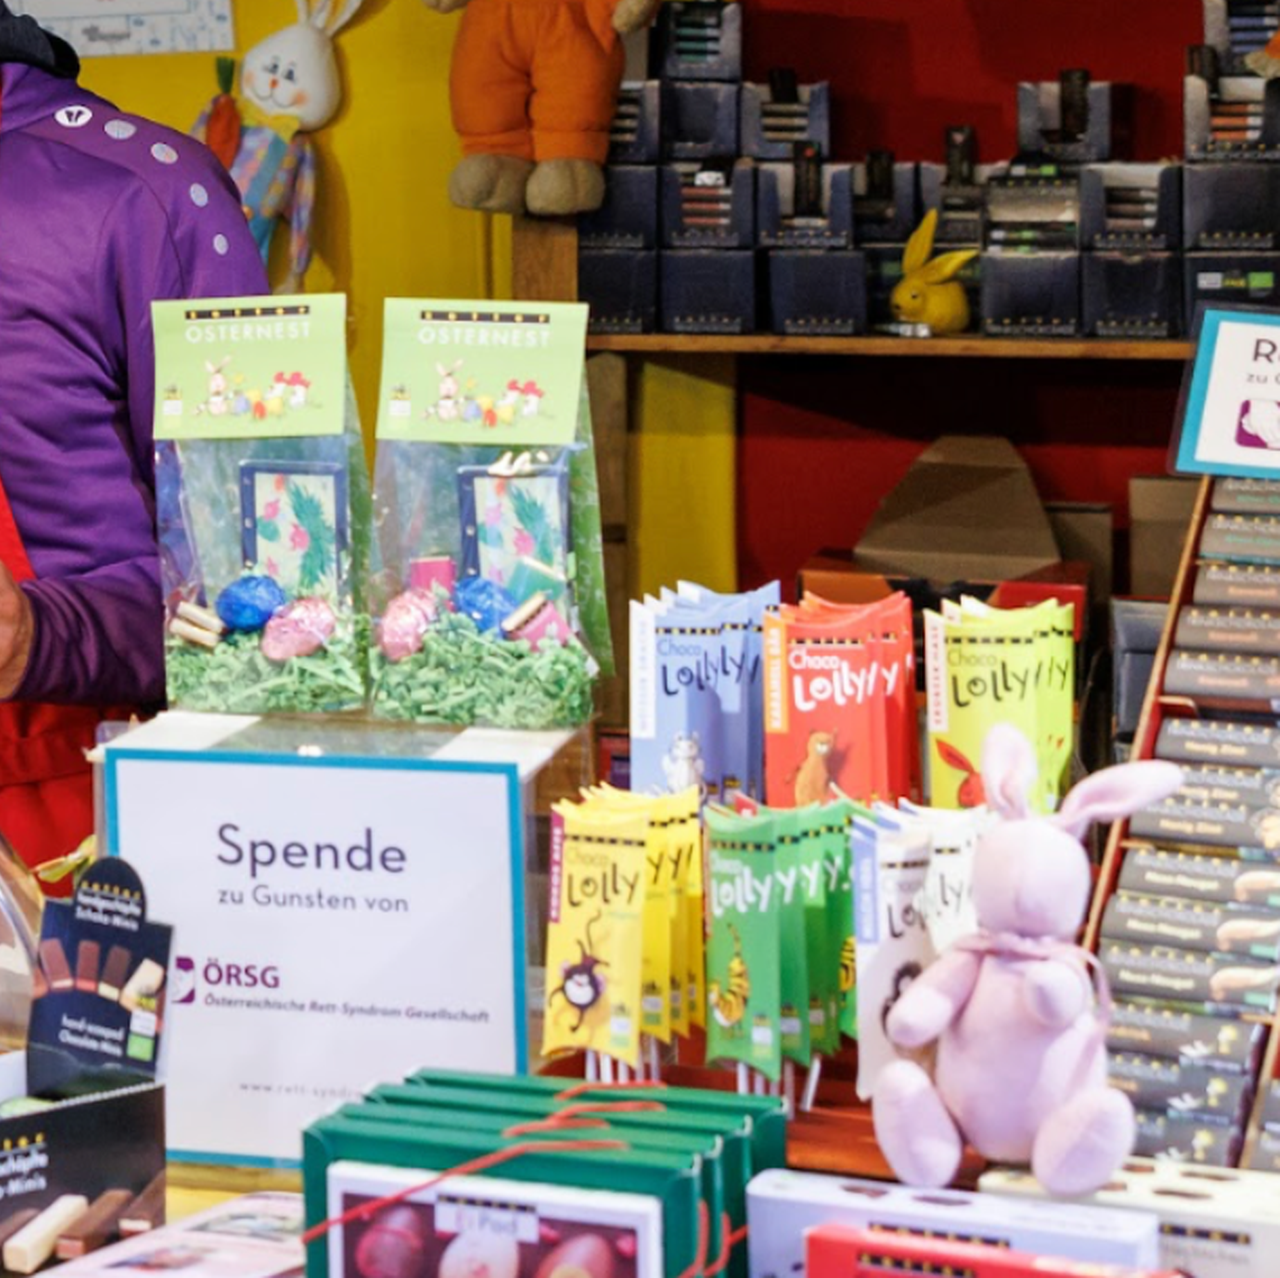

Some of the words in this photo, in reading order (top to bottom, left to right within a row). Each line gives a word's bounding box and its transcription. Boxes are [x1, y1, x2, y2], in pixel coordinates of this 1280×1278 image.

[185, 320, 311, 344] OSTERNEST
[417, 326, 551, 348] OSTERNEST
[788, 647, 840, 671] Choco
[951, 661, 1030, 709] Lolly
[216, 823, 408, 879] Spende
[217, 888, 244, 906] zu
[252, 884, 358, 913] Gunsten
[365, 893, 410, 914] von
[567, 862, 640, 908] Lolly
[710, 865, 773, 919] Lolly
[202, 956, 281, 990] ÖRSG
[203, 992, 308, 1014] Österreichische
[309, 999, 404, 1021] Rett-Syndrom
[405, 1003, 491, 1024] Gesellschaft
